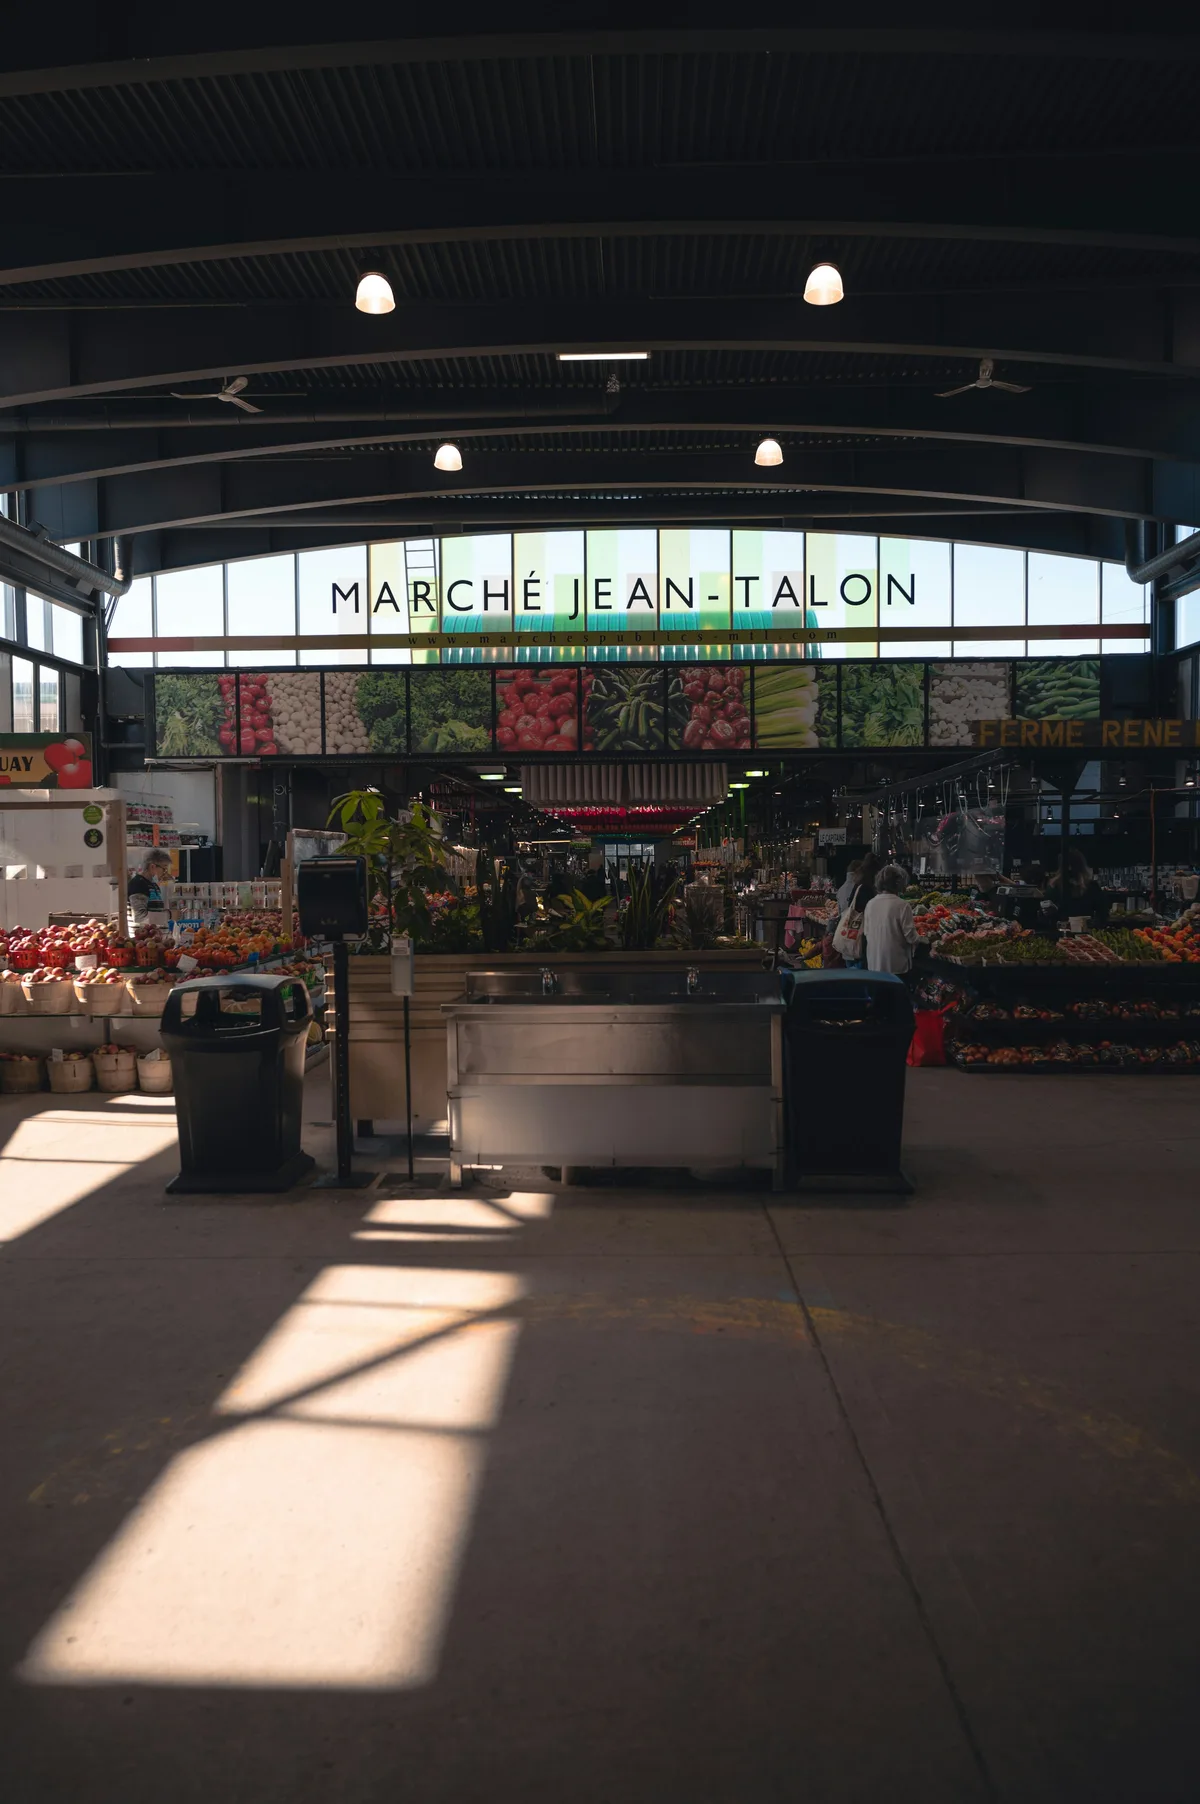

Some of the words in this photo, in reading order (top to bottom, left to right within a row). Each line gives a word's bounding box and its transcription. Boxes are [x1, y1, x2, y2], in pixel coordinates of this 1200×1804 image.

[332, 570, 541, 613] MARCHÉ
[568, 573, 915, 620] JEAN-TALON
[408, 630, 837, 645] www.marchespublics-mtl.com
[978, 719, 1085, 747] FERME
[1102, 719, 1183, 747] RENE
